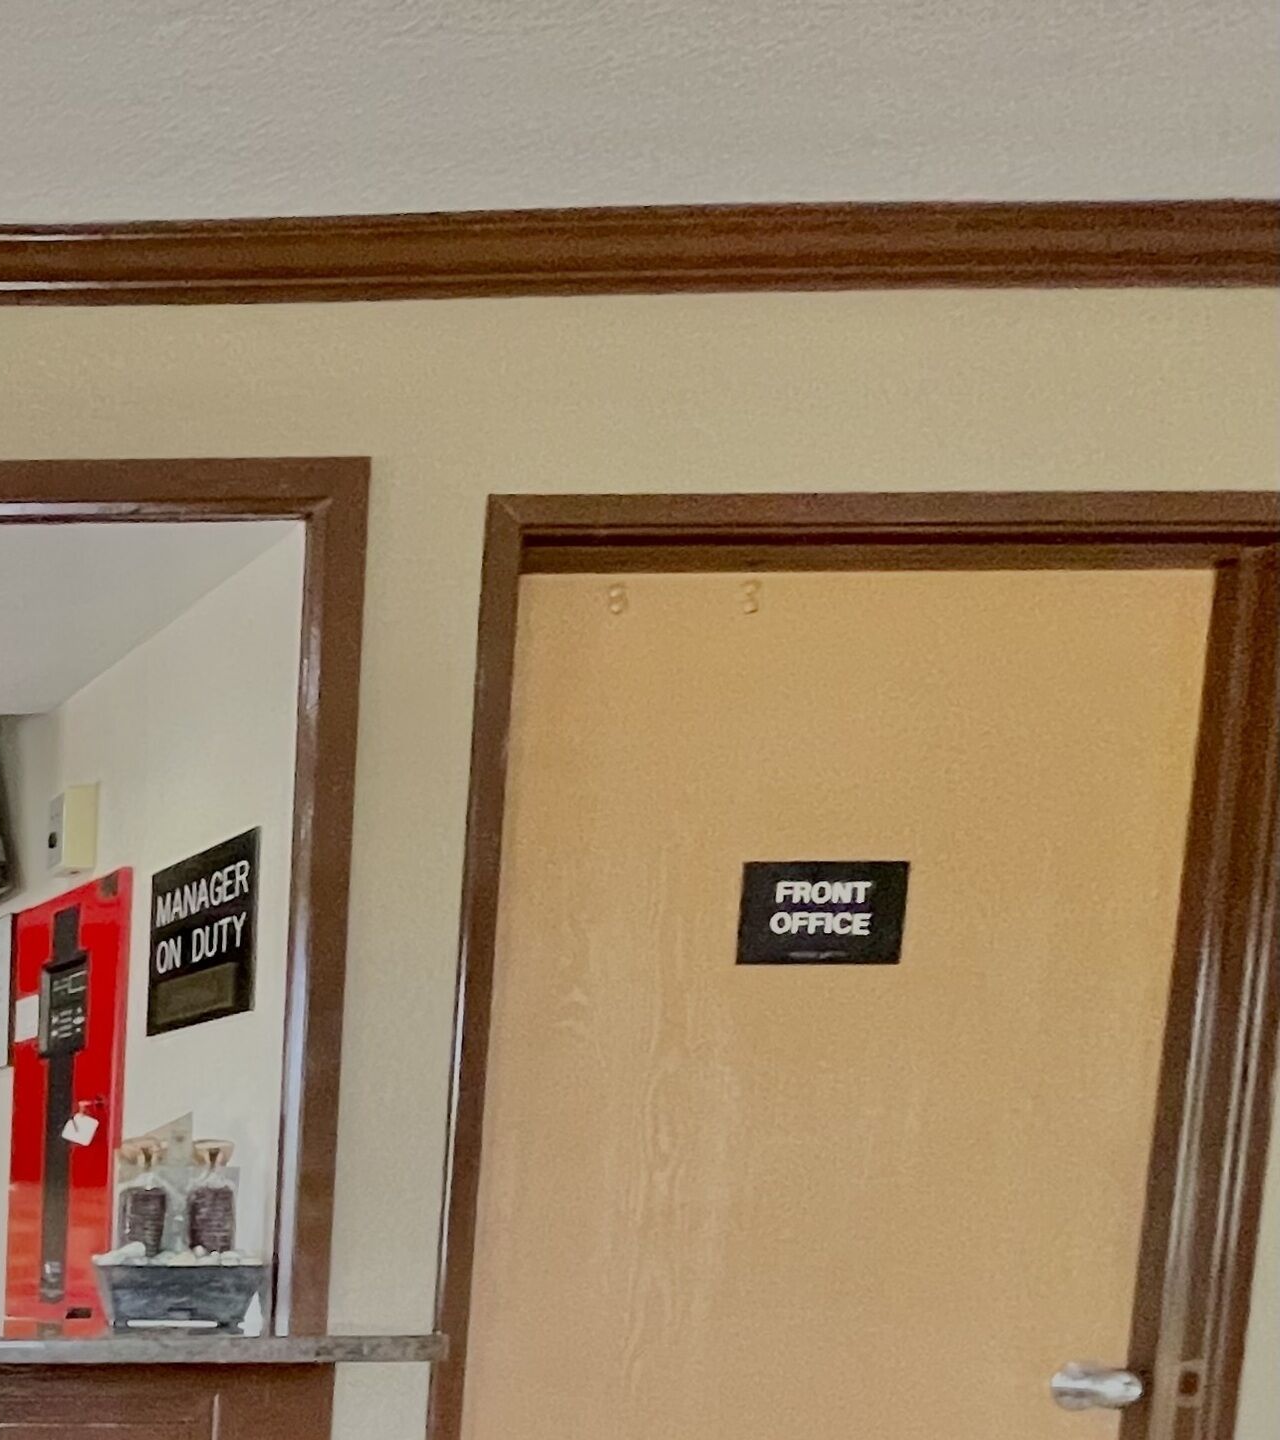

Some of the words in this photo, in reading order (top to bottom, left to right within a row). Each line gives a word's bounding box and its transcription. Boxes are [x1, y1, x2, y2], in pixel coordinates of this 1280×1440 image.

[156, 860, 250, 927] MANAGER
[775, 881, 872, 904] FRONT
[156, 936, 182, 974] ON
[192, 912, 247, 963] DUTY
[769, 912, 873, 935] OFFICE
